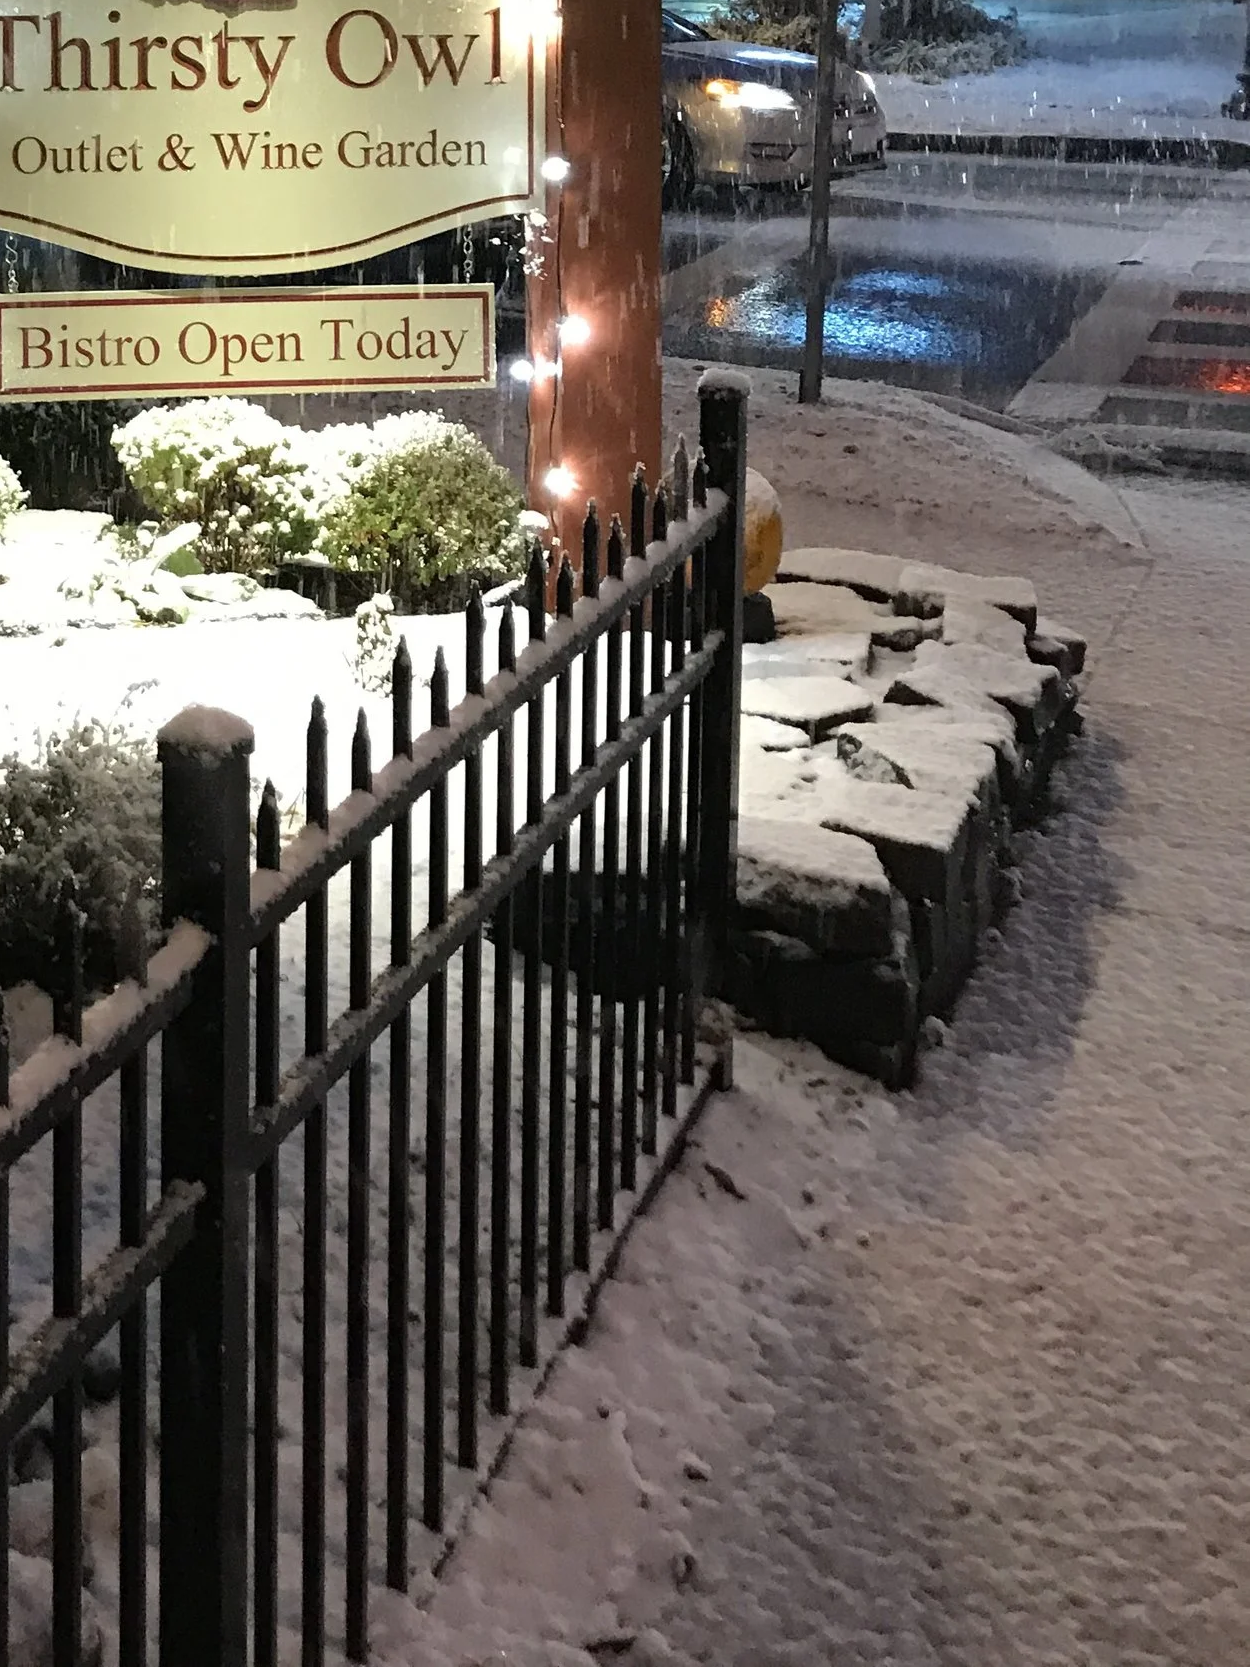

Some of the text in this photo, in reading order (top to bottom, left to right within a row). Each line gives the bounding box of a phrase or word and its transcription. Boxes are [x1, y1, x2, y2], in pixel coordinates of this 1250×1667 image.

[325, 7, 508, 89] Owl
[11, 129, 488, 174] Outlet & Wine Garden
[18, 316, 469, 376] Bistro Open Today
